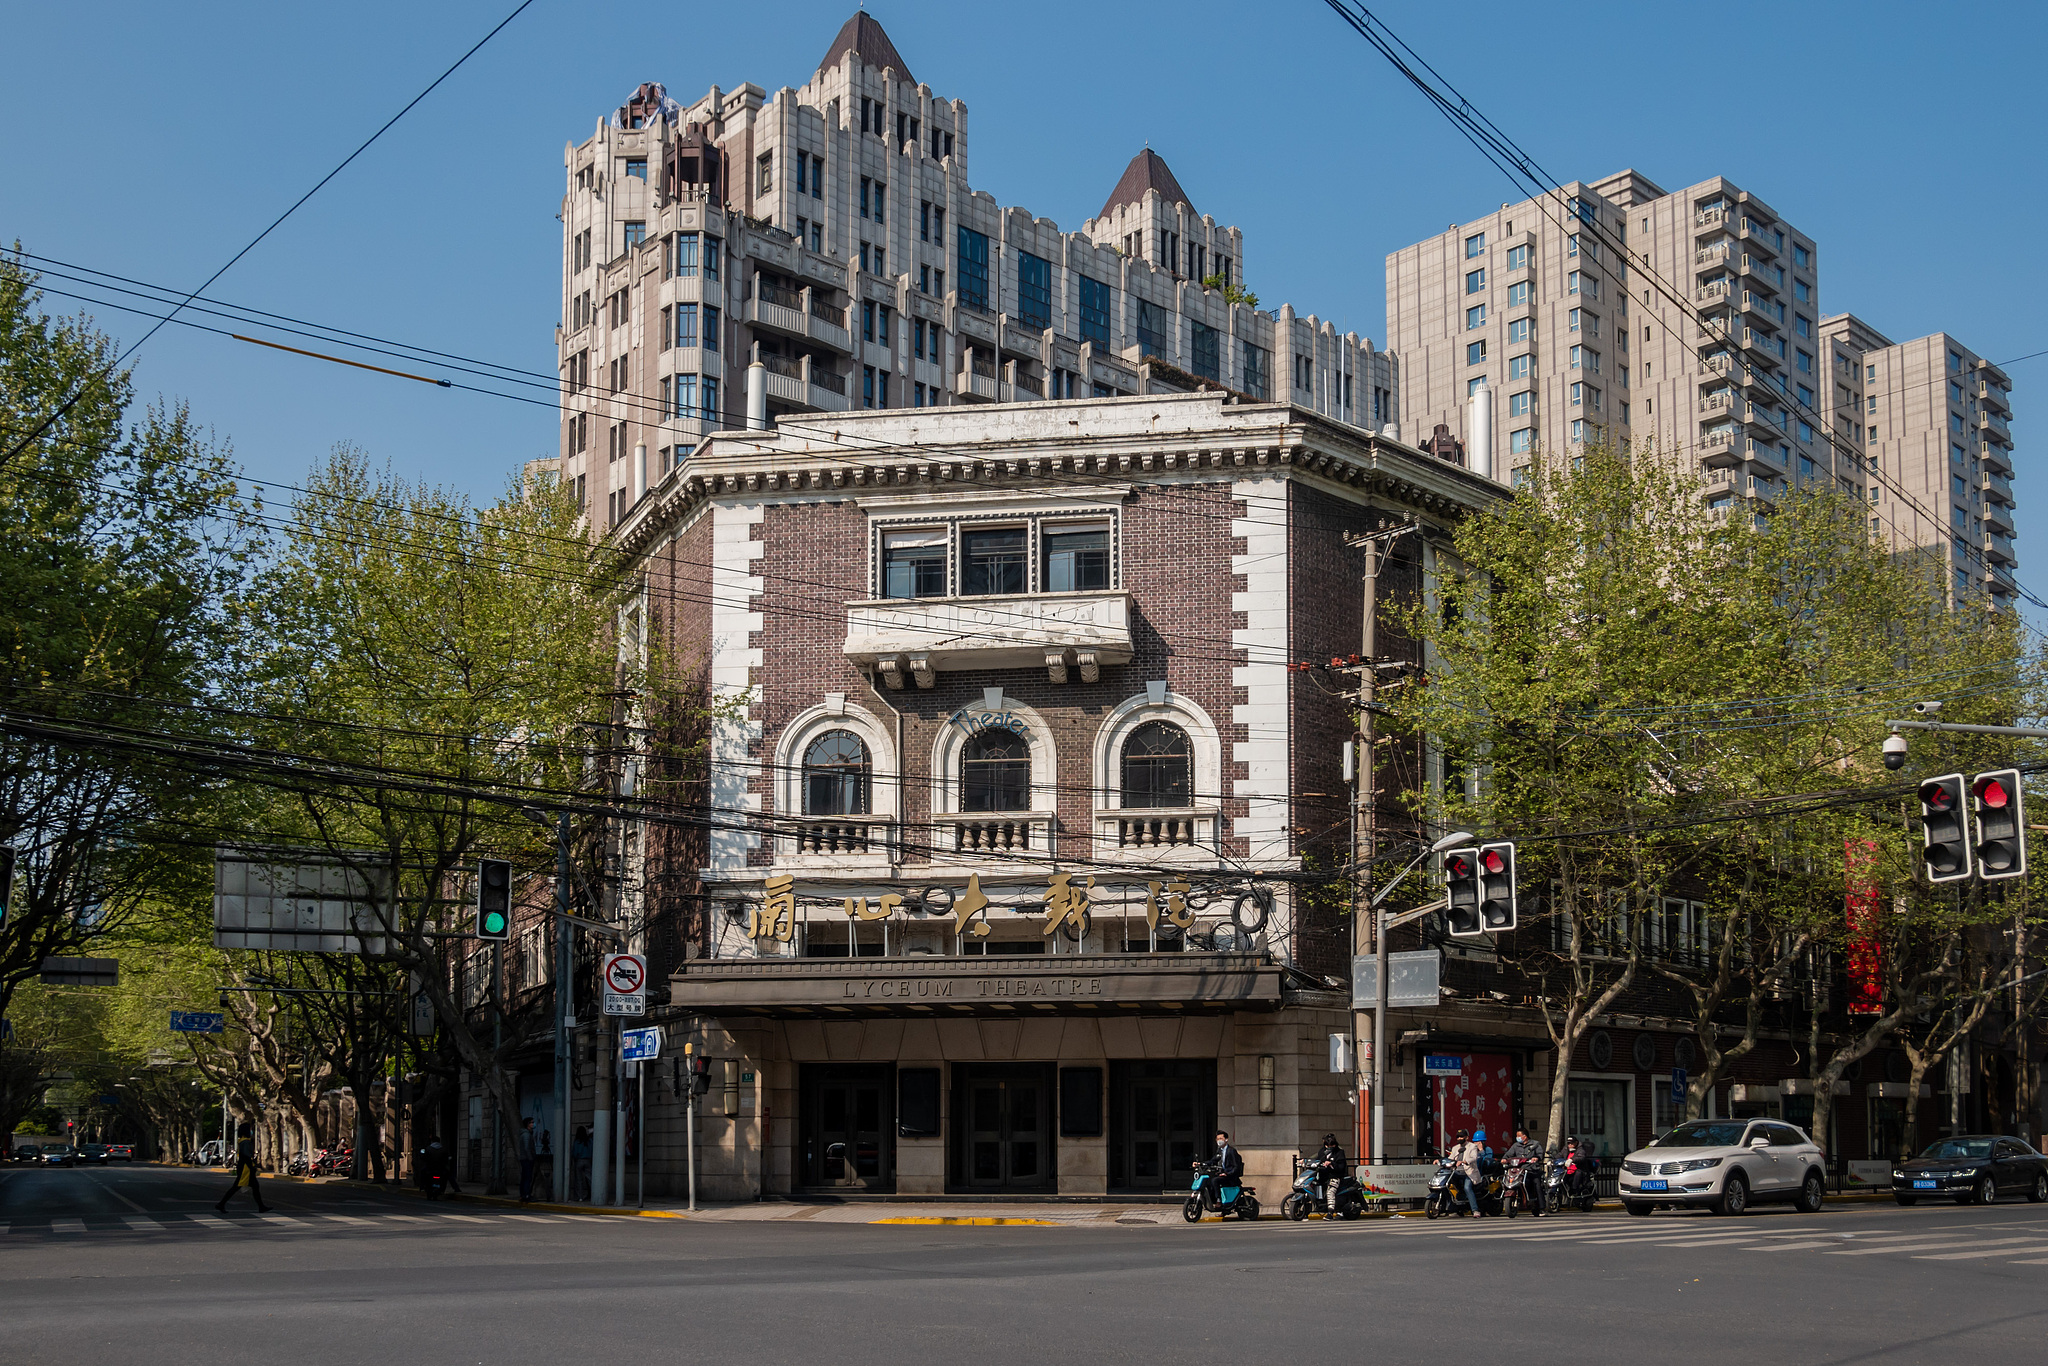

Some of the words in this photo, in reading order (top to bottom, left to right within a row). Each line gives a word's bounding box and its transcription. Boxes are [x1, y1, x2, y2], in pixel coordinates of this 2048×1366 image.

[949, 709, 1030, 735] Theater
[842, 980, 953, 998] LYCEUM
[977, 979, 1102, 997] THEATRE
